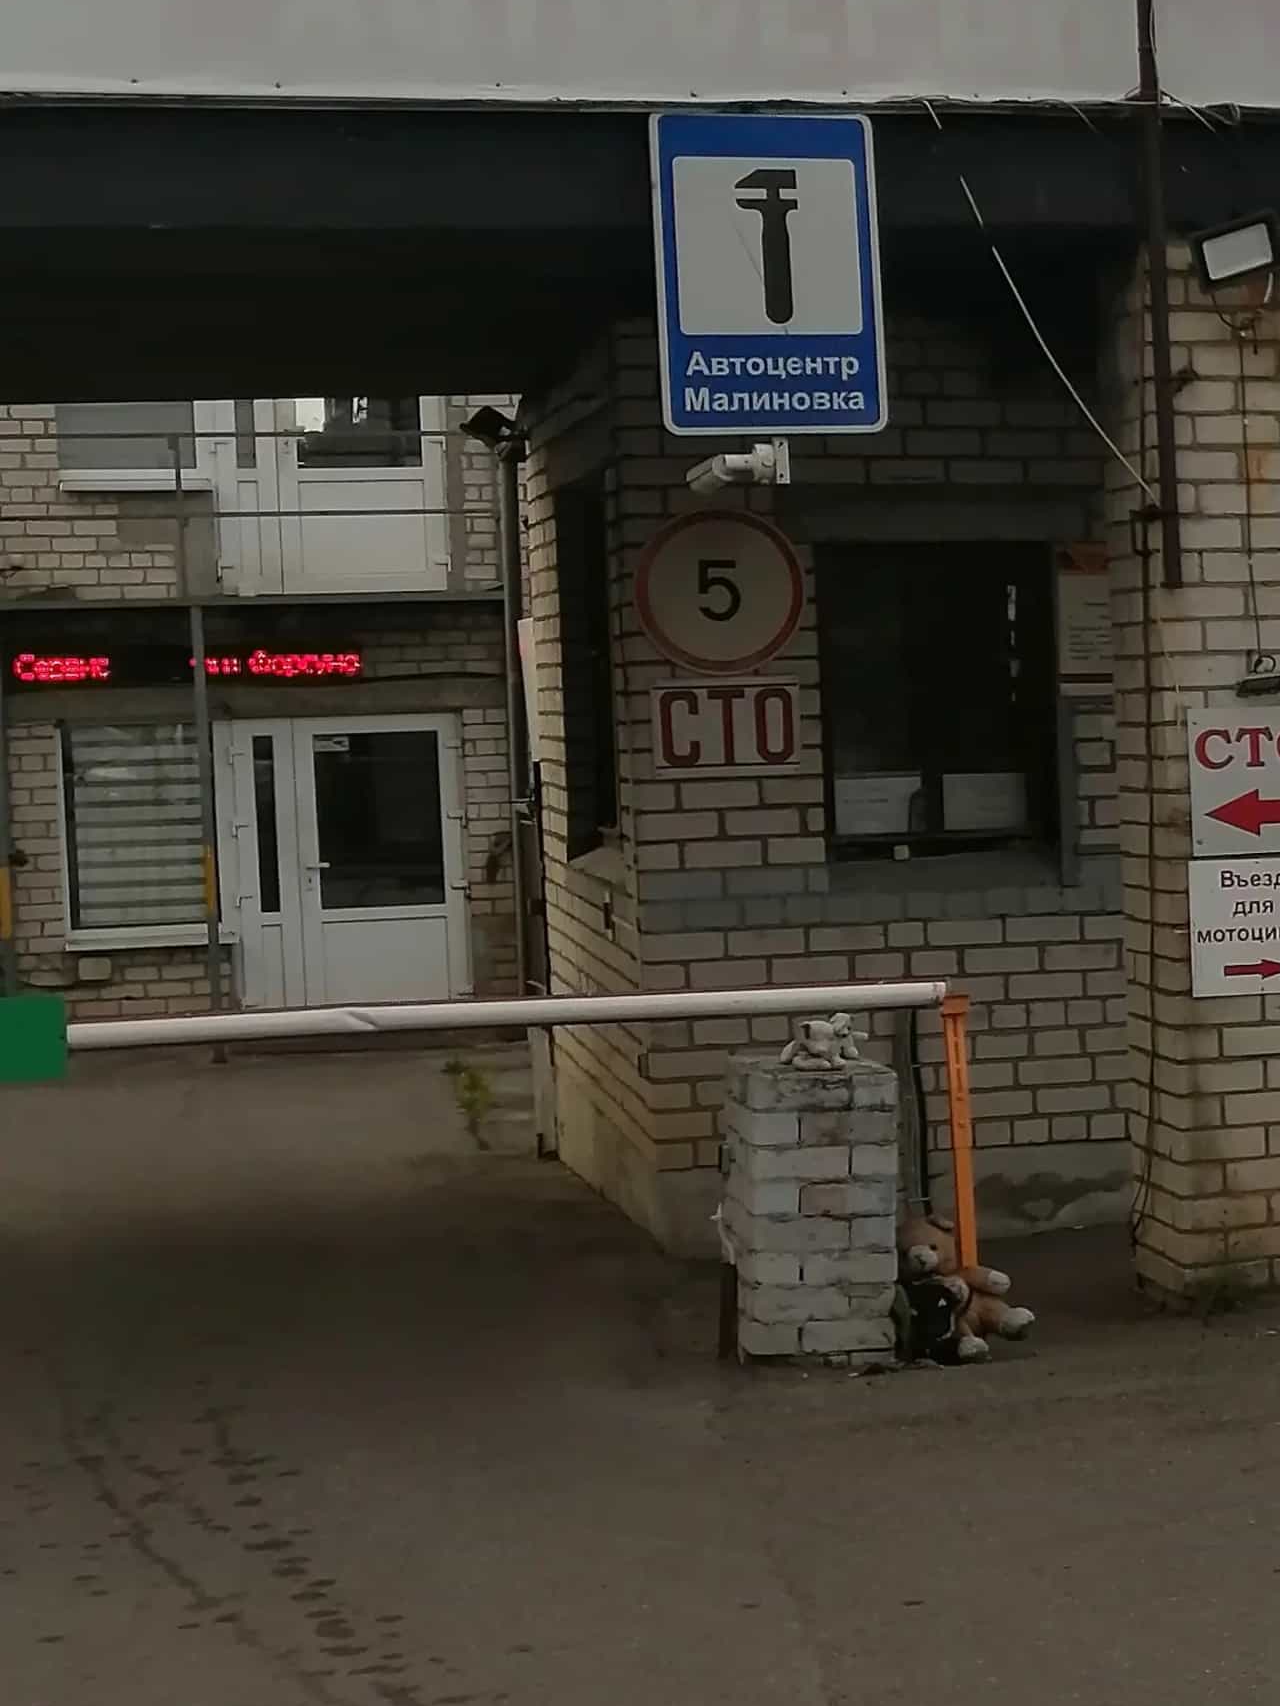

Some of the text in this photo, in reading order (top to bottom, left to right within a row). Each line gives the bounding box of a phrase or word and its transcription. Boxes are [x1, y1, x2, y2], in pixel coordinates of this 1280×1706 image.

[685, 351, 860, 380] Автоцентр
[684, 387, 865, 412] Малиновка
[697, 559, 742, 621] 5
[659, 687, 796, 767] СТО
[1232, 900, 1274, 917] для
